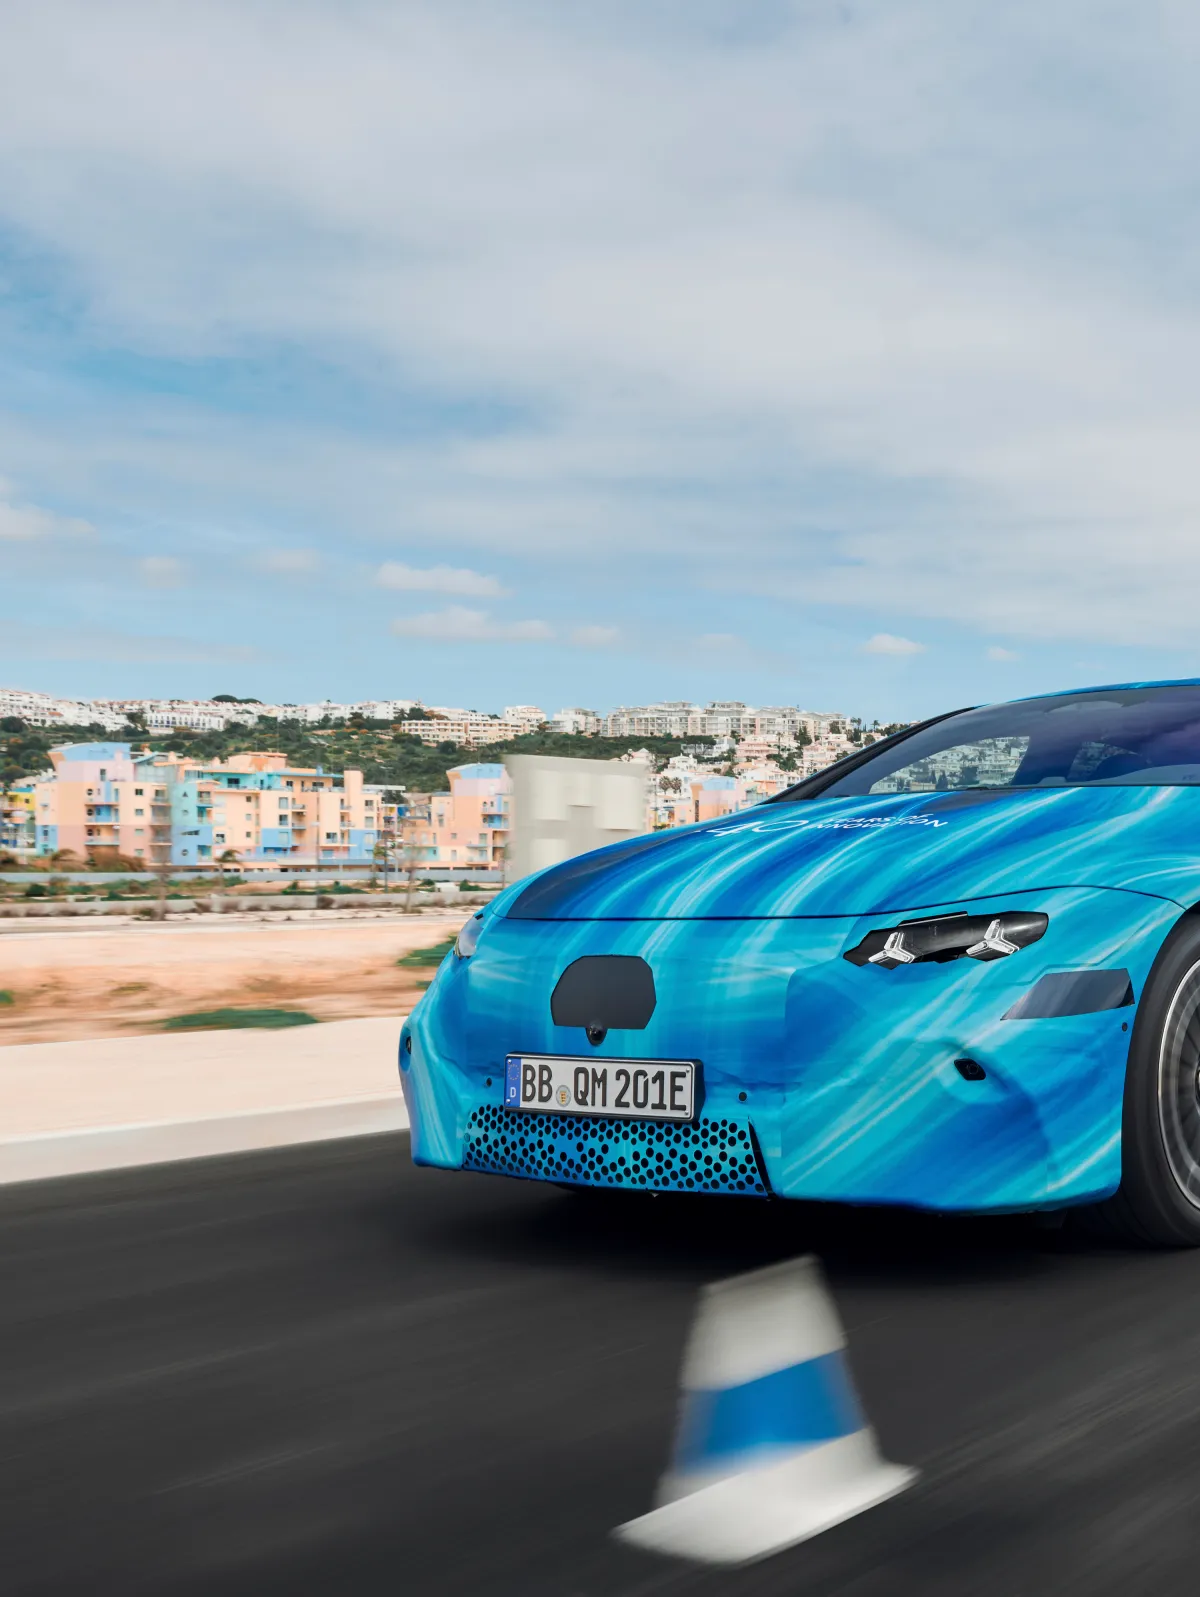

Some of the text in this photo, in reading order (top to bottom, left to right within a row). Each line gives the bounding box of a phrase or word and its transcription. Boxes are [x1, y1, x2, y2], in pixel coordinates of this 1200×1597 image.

[693, 821, 809, 837] 40
[509, 1086, 517, 1098] D
[521, 1064, 687, 1111] BB QM 201E
